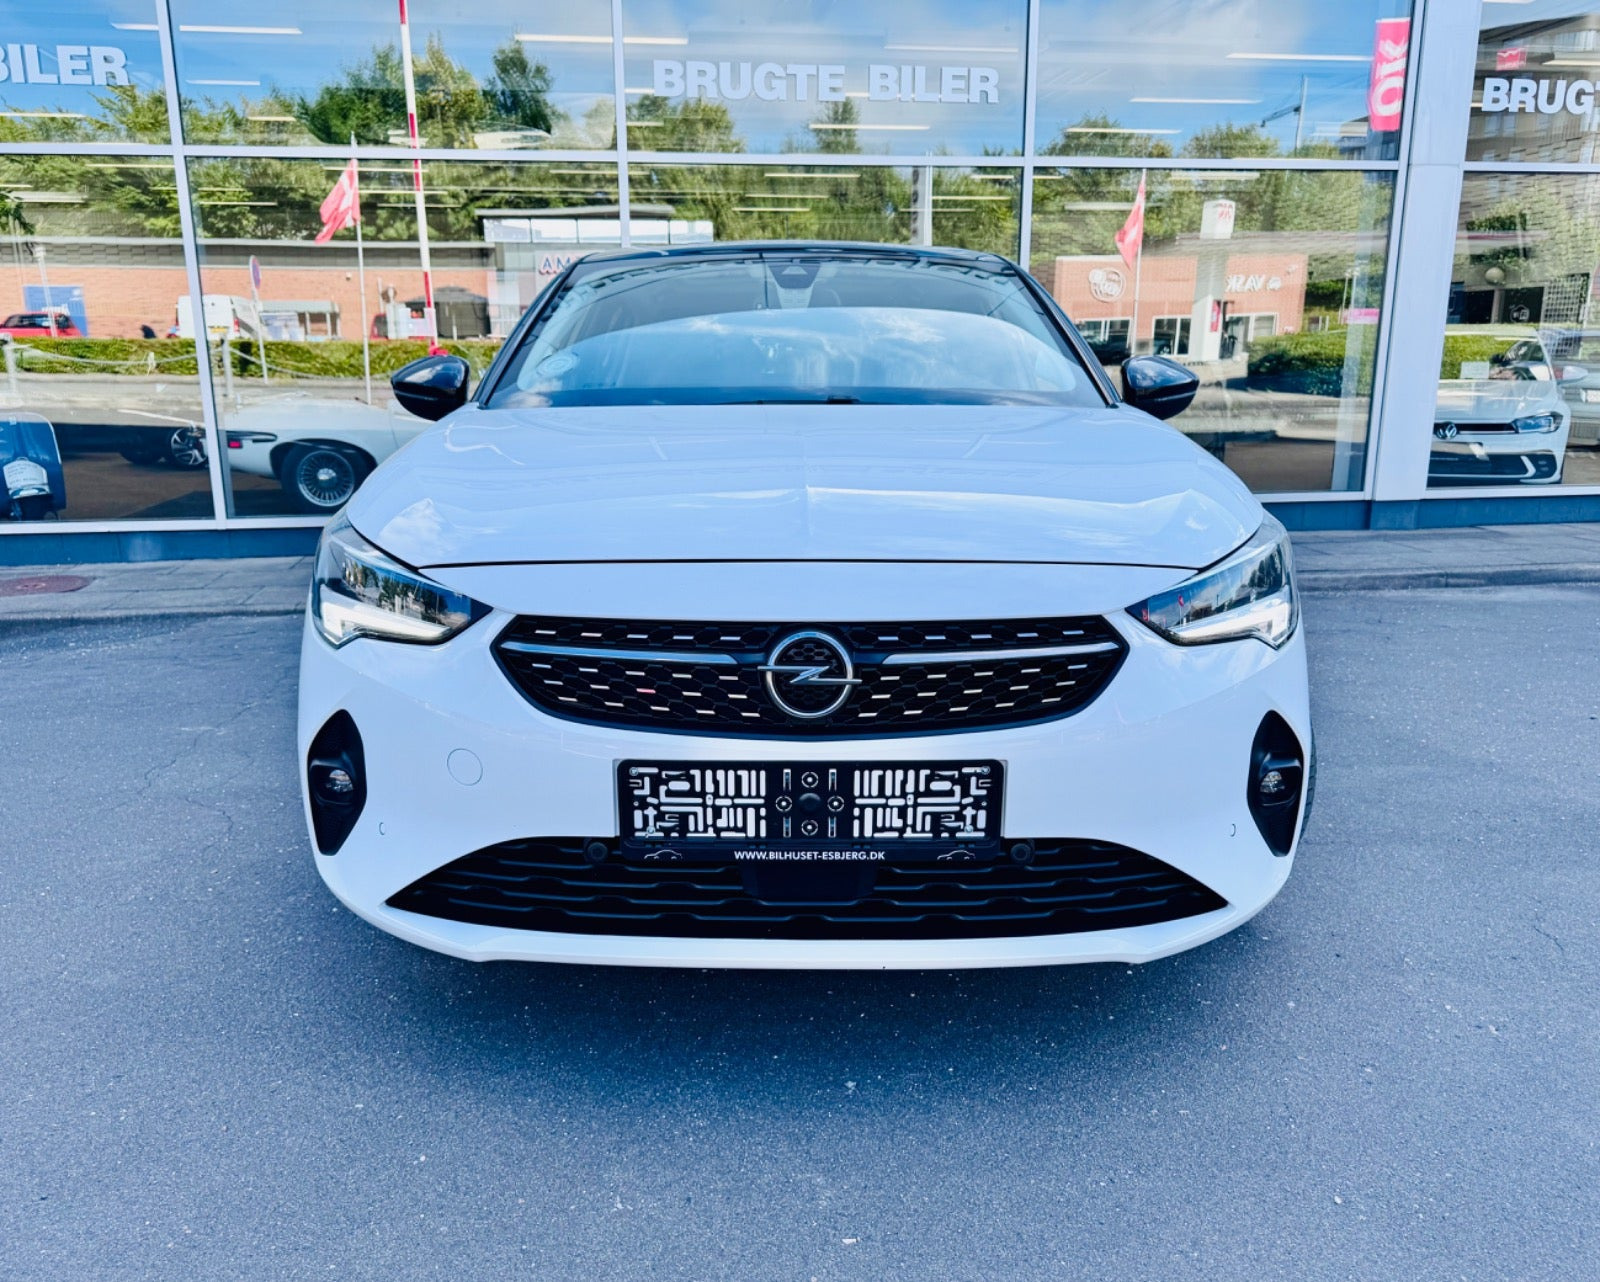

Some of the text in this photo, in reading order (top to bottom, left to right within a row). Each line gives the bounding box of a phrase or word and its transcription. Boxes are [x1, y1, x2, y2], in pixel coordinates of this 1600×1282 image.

[652, 59, 1000, 104] BRUGTE BILER
[1481, 77, 1600, 116] BRUG
[733, 850, 886, 861] WWW.BILHUSET-ESBJERG.DK
